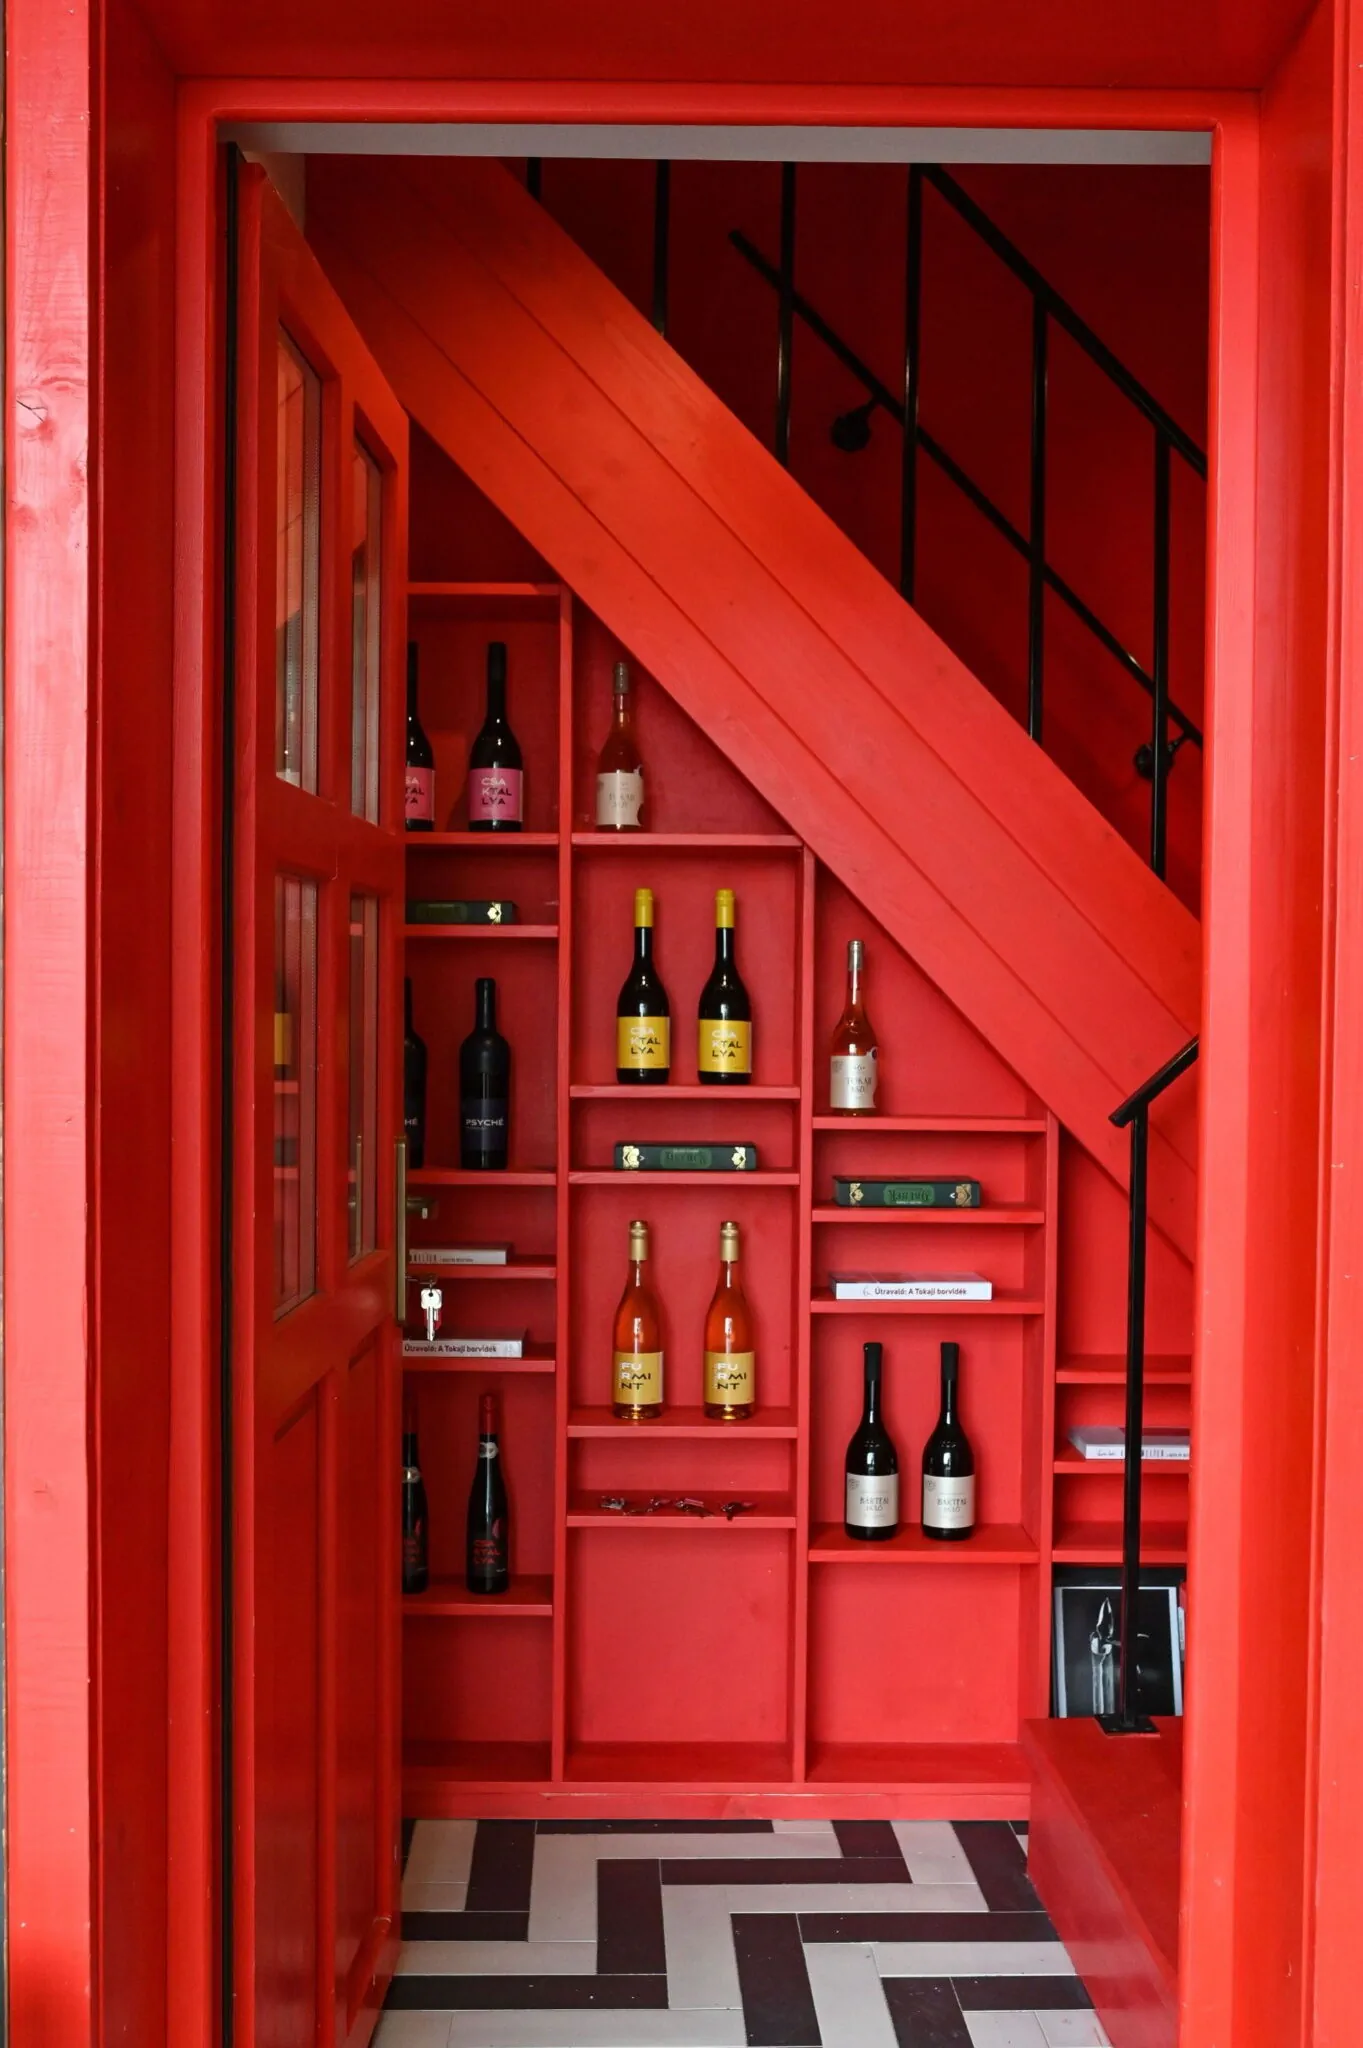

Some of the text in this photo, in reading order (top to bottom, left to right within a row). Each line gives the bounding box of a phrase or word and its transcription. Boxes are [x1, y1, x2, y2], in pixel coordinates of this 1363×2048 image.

[405, 776, 419, 785] SA
[481, 777, 506, 786] CSA
[405, 787, 424, 796] TAL
[481, 797, 506, 805] LYA
[630, 1047, 655, 1055] LYA
[711, 1050, 736, 1058] LYA
[874, 1286, 907, 1295] Útravaló:
[915, 1288, 936, 1296] Tokaji
[937, 1287, 967, 1295] borvidék
[445, 1345, 466, 1353] Tokaji
[621, 1362, 642, 1370] FU
[717, 1363, 738, 1371] FU
[621, 1372, 651, 1380] RMI
[717, 1372, 747, 1380] RMI
[621, 1382, 643, 1390] NT
[717, 1382, 740, 1390] NT
